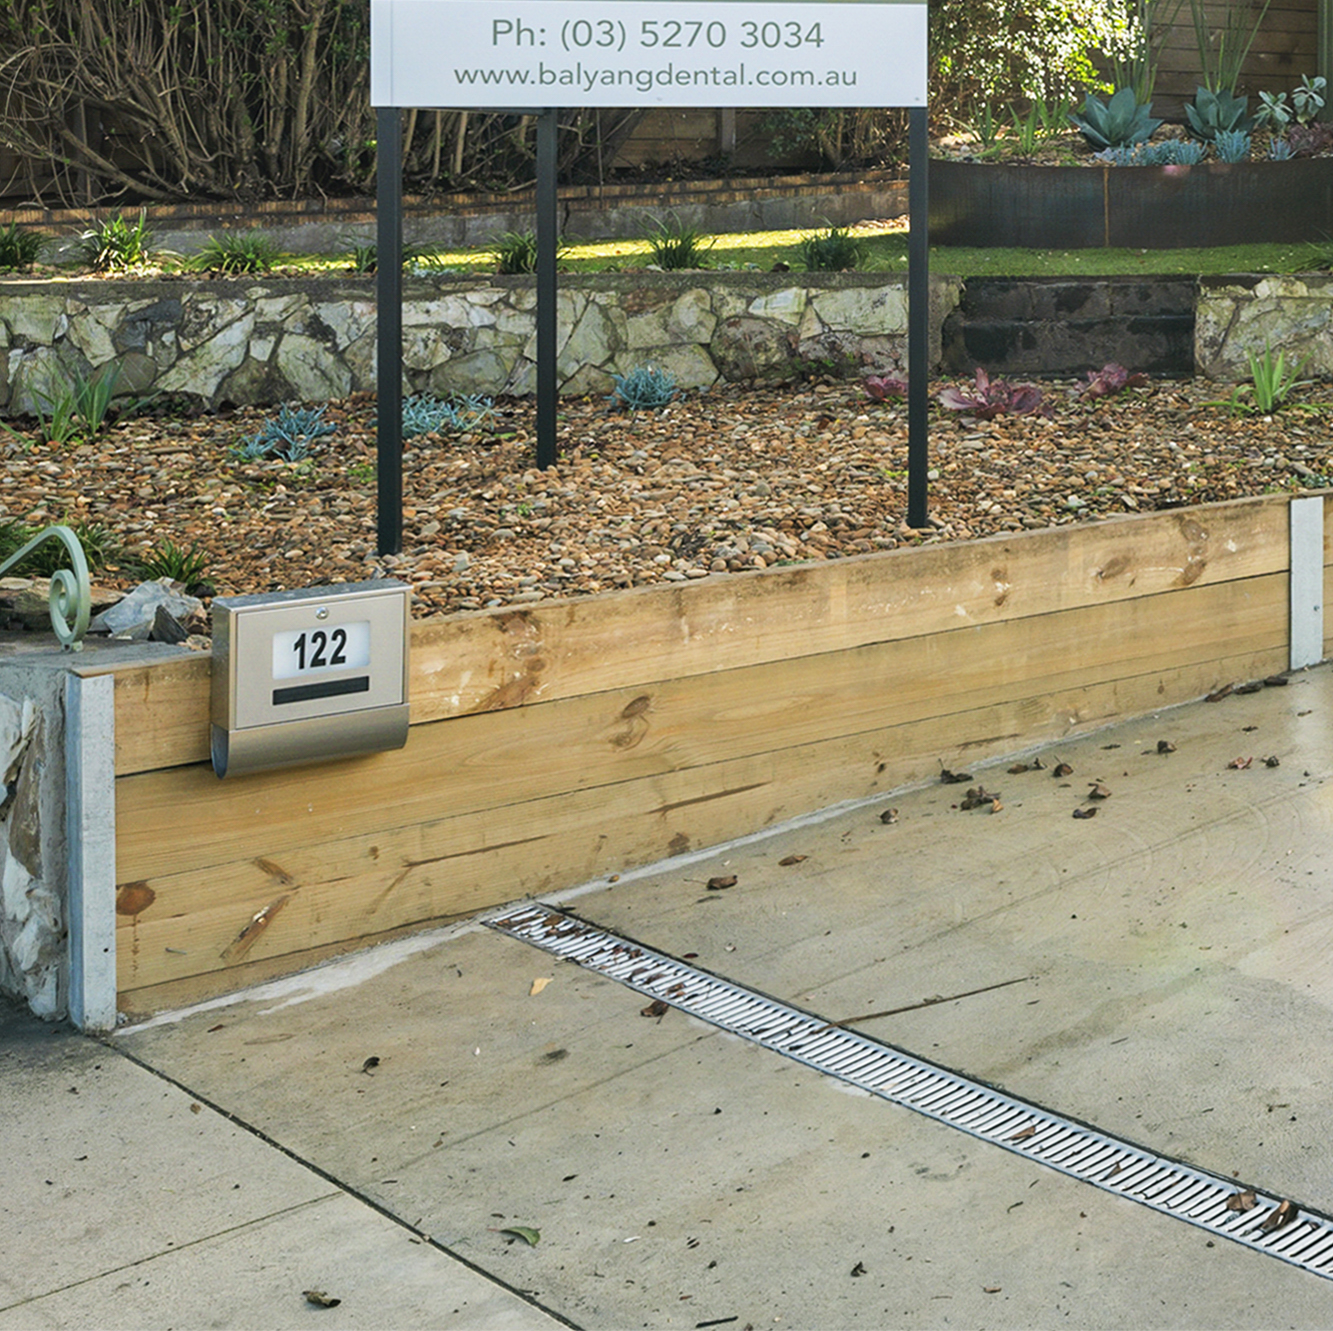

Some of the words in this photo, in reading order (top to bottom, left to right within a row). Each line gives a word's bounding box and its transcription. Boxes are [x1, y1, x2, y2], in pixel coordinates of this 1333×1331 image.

[491, 17, 546, 47] Ph:
[560, 19, 627, 52] (03)
[640, 20, 727, 48] 5270
[740, 21, 825, 49] 3034
[453, 62, 858, 92] www.balyangdental.com.au
[293, 628, 347, 670] 122
